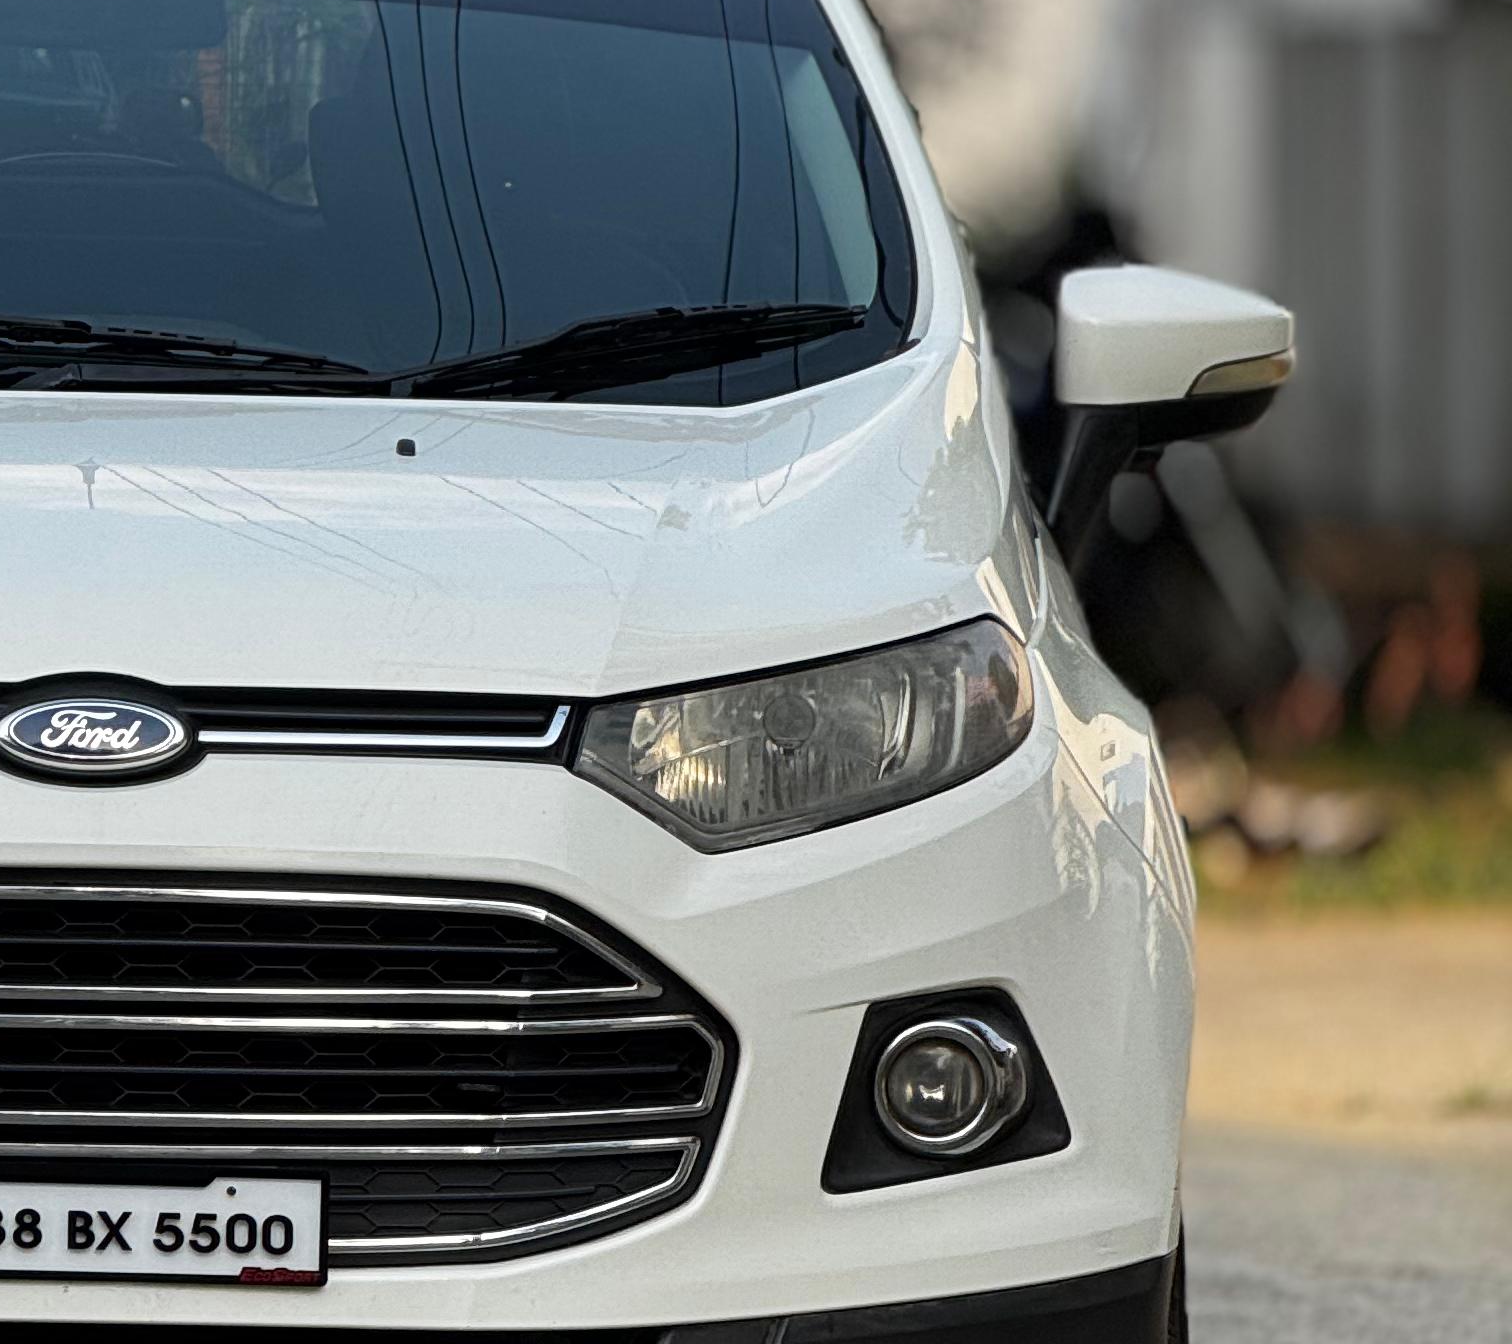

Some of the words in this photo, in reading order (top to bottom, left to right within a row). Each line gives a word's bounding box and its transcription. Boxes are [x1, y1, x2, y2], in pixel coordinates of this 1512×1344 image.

[40, 709, 142, 750] Ford
[67, 1210, 132, 1251] BX
[153, 1212, 294, 1255] 5500
